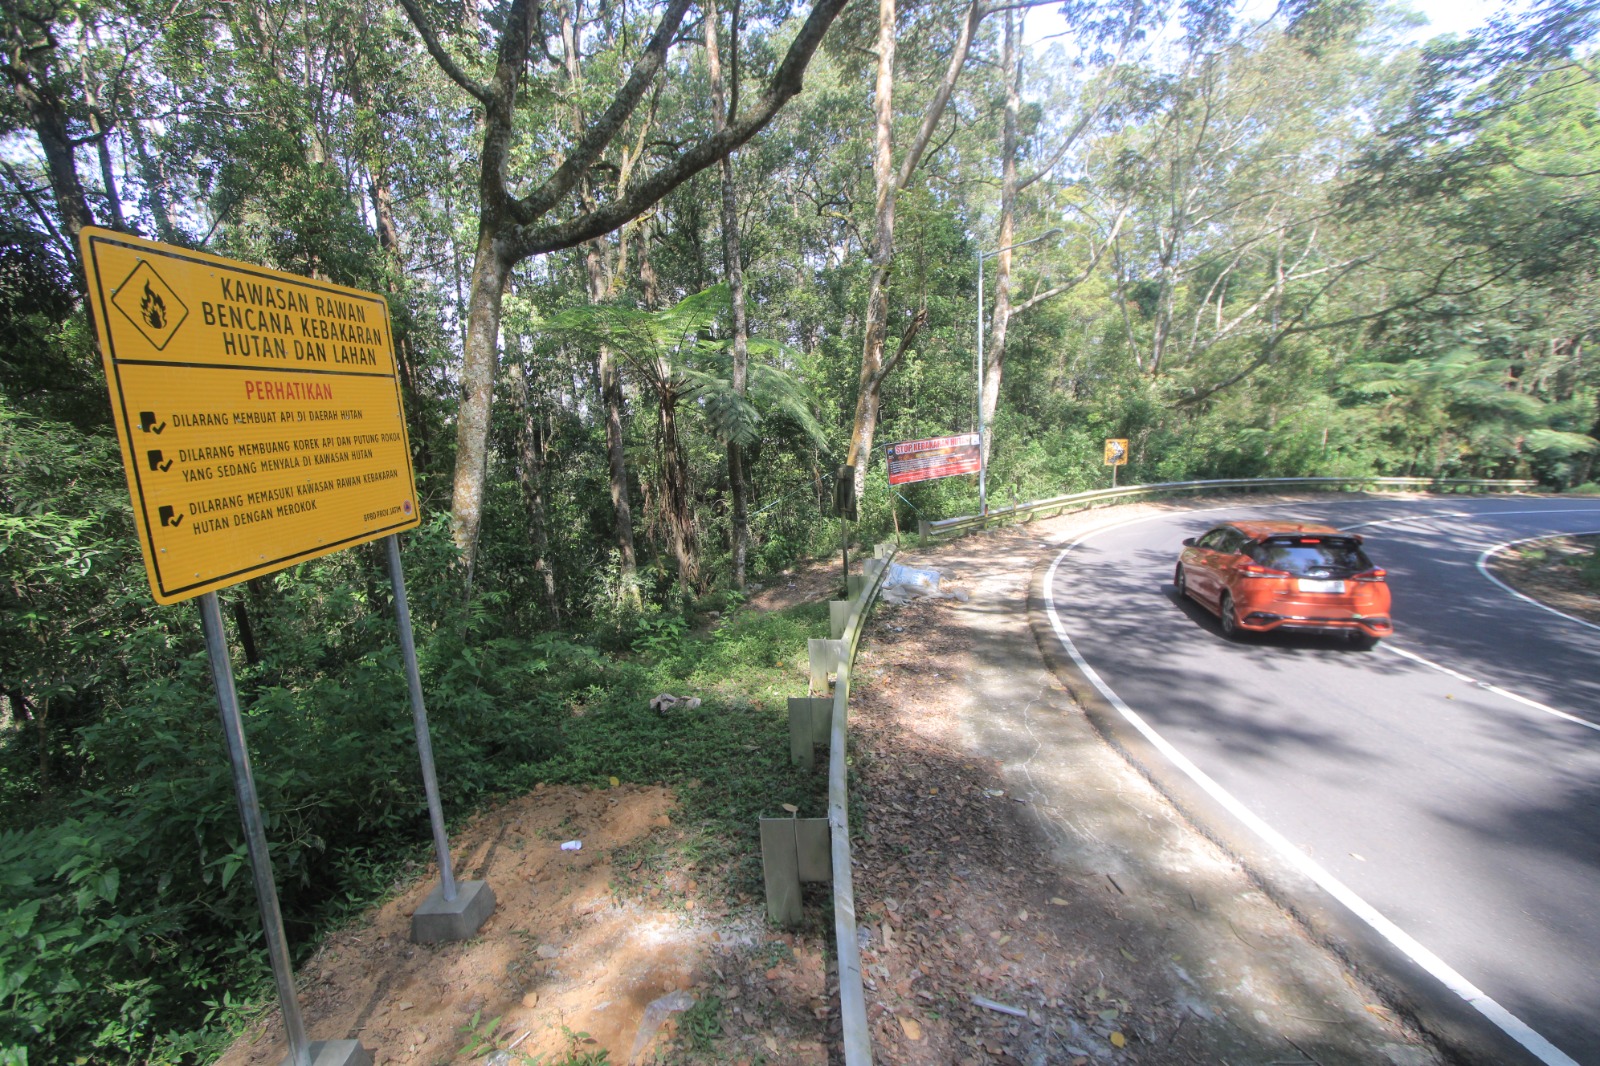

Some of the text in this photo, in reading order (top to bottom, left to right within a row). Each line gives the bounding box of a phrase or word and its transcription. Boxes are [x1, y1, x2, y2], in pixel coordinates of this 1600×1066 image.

[220, 277, 366, 323] KAWASAN RAWAN
[201, 301, 382, 346] BENCANA KEBAKARAN
[223, 332, 377, 366] HUTAN DAN LAHAN
[245, 380, 333, 400] PERHATIKAN
[172, 410, 363, 427] DILARANG MEMBUAT API DI DAERAH HUTAN
[179, 432, 401, 462] DILARANG MEMBUANG KOREK API DAN PUTUNG ROKOK
[895, 444, 913, 454] STOP
[182, 449, 373, 483] YANG SEDANG MENYALA DI KAWASAN HUTAN
[189, 469, 398, 516] DILARANG MEMASUKI KAWASAN RAWAN KEBAKARAN
[193, 499, 318, 535] HUTAN DENGAN MEROKOK
